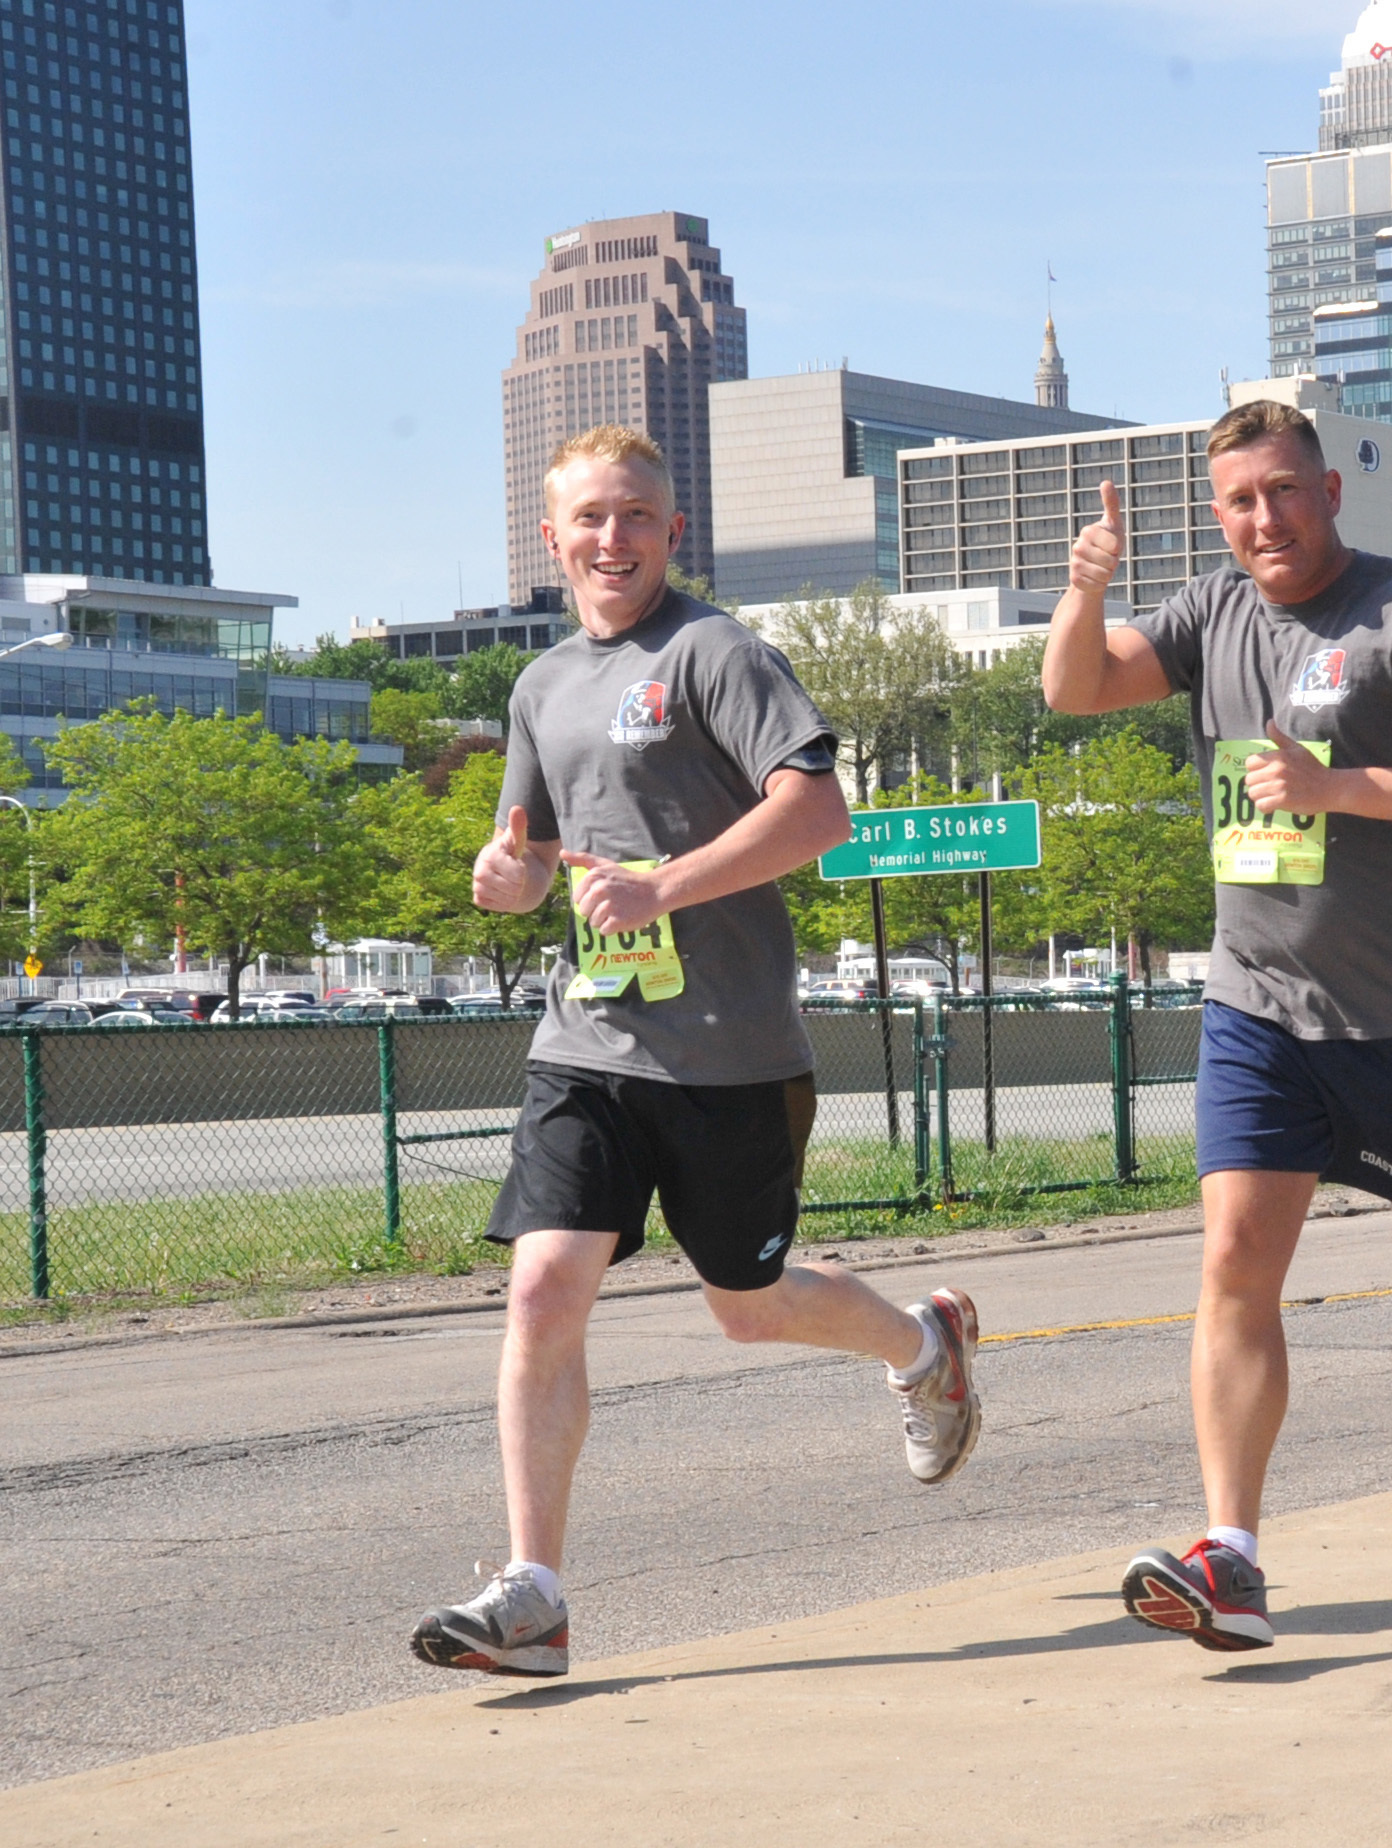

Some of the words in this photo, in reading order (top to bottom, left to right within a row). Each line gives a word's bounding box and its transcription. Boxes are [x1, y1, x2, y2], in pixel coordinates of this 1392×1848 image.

[849, 821, 891, 843] Carl
[904, 819, 921, 840] B.
[930, 816, 1007, 838] Stokes
[1248, 831, 1303, 843] NEWTON
[869, 851, 925, 867] Memorial
[932, 849, 987, 864] Highway
[610, 951, 656, 963] NEWTON
